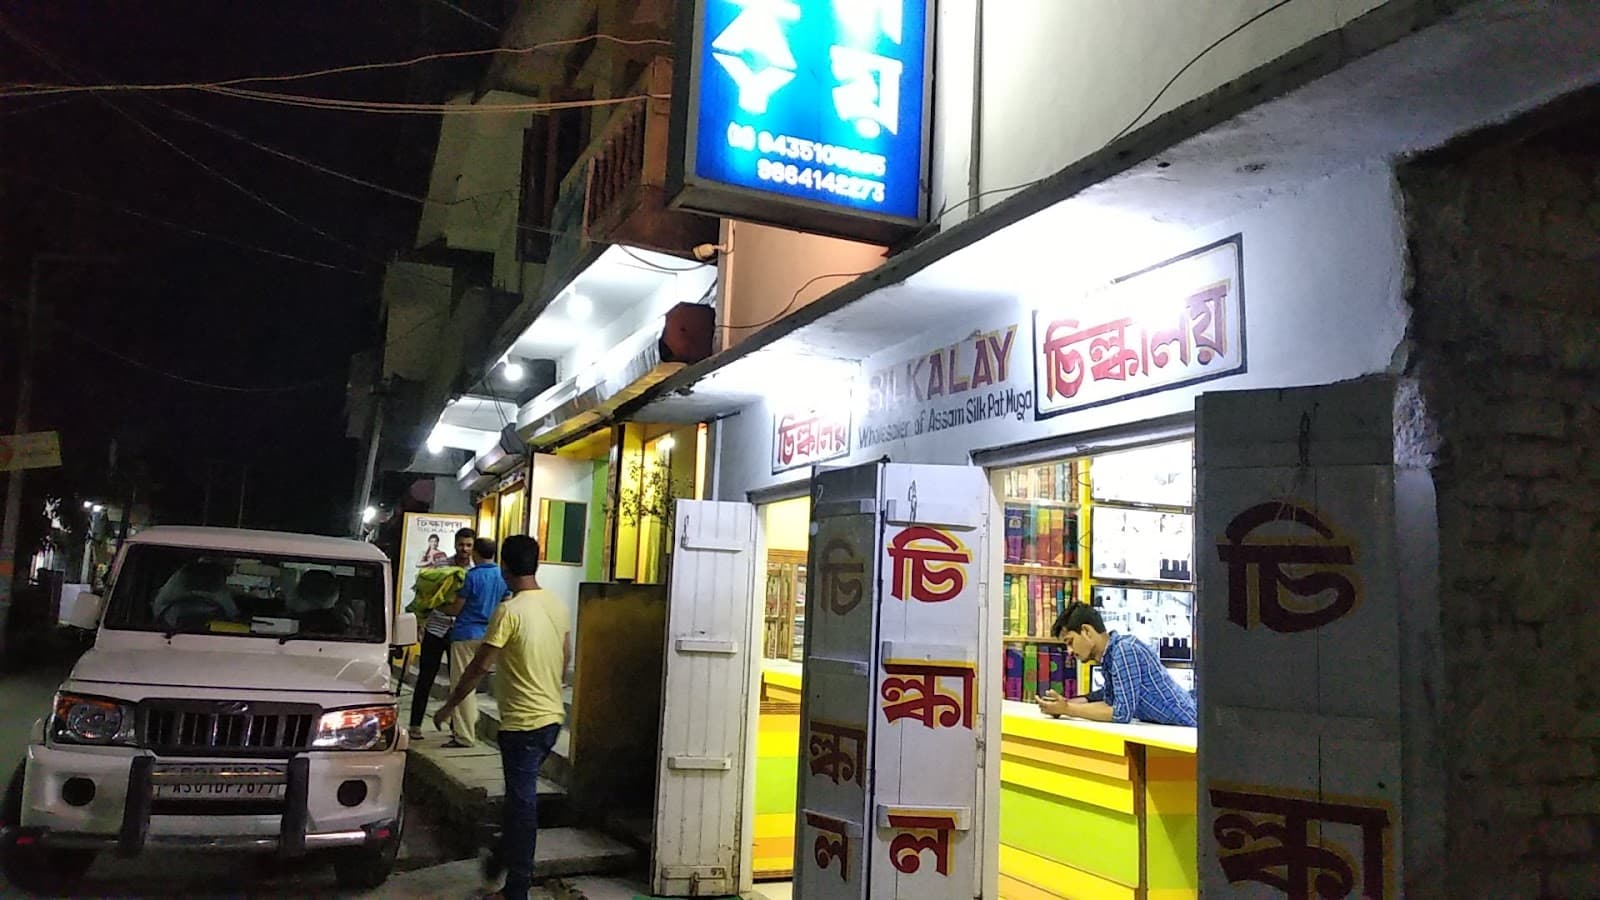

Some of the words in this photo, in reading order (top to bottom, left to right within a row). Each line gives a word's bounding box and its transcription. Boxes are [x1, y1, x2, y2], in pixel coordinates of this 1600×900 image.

[868, 324, 1018, 416] SILKALAY
[914, 409, 927, 435] of
[928, 408, 965, 433] Assam
[966, 394, 987, 424] Silk
